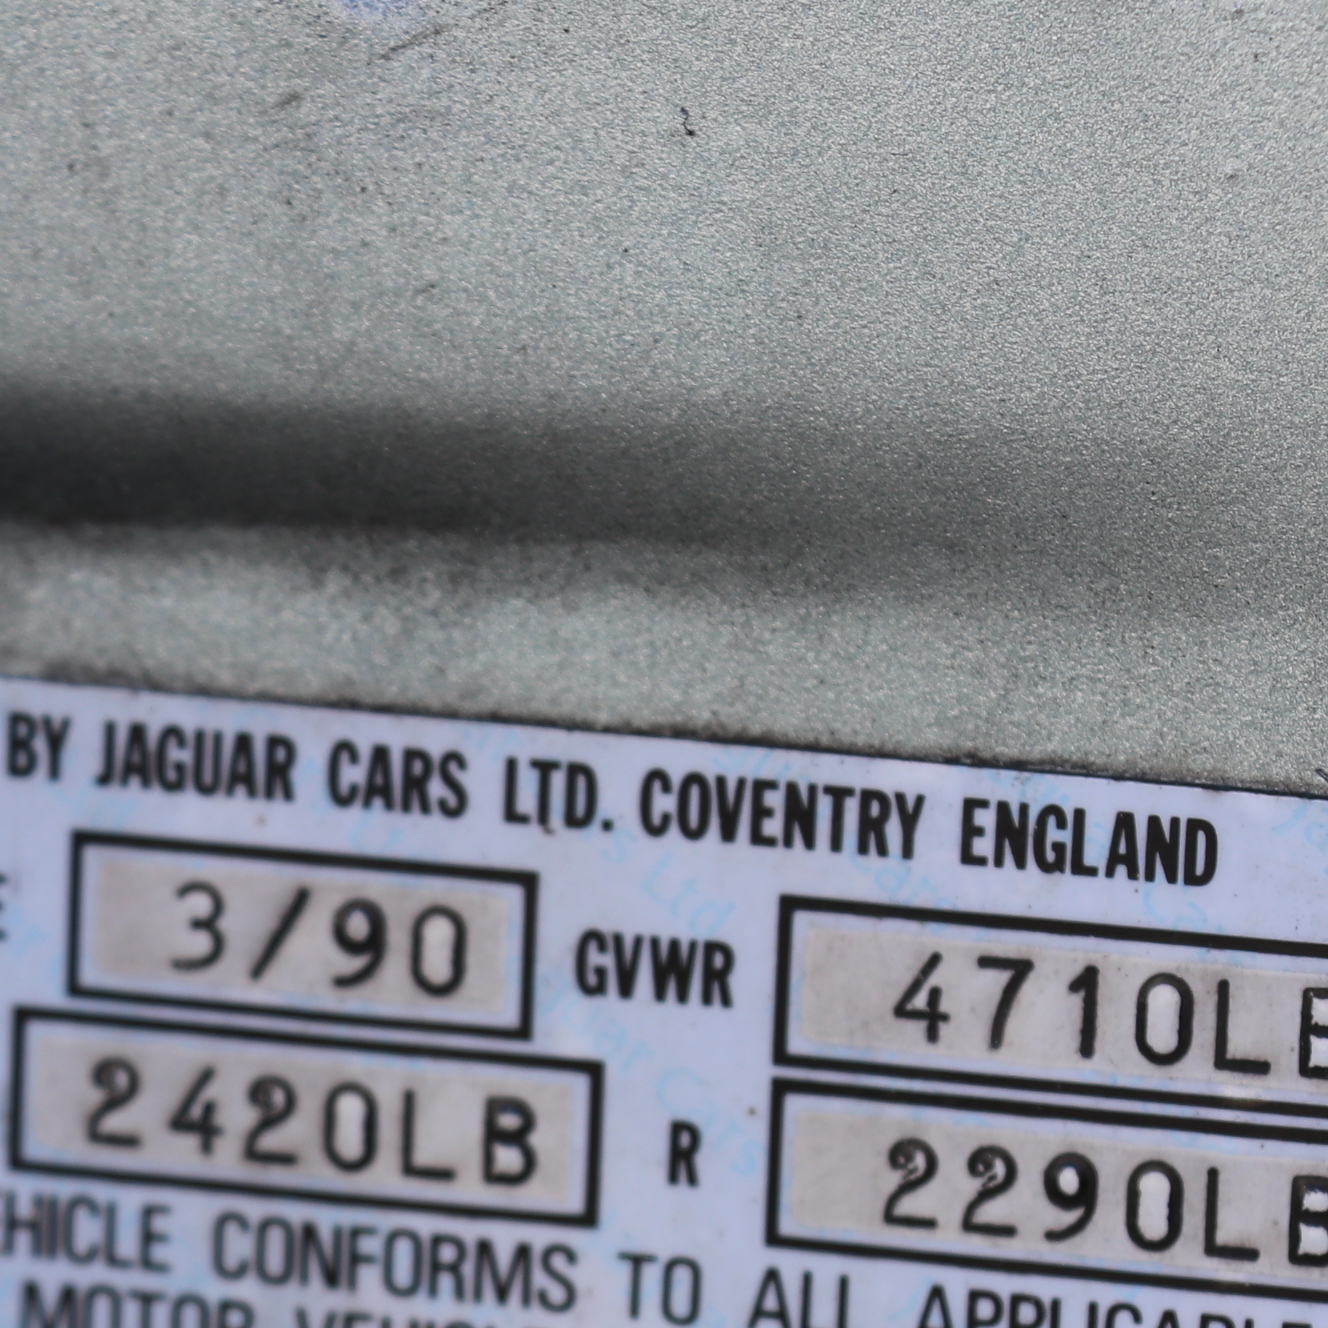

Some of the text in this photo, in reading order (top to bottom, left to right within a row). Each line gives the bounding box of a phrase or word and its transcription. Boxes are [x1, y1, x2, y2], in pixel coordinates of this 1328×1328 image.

[7, 713, 72, 781] BY
[95, 722, 296, 802] JAGUAR
[327, 740, 468, 818] CARS
[504, 757, 613, 834] LTD.
[641, 769, 925, 860] COVENTRY
[960, 797, 1218, 888] ENGLAND
[170, 880, 468, 997] 3/90
[575, 930, 735, 1007] GVWR
[87, 1058, 537, 1186] 2420LB
[668, 1122, 701, 1187] R
[214, 1210, 576, 1313] CONFORMS
[618, 1252, 702, 1327] TO
